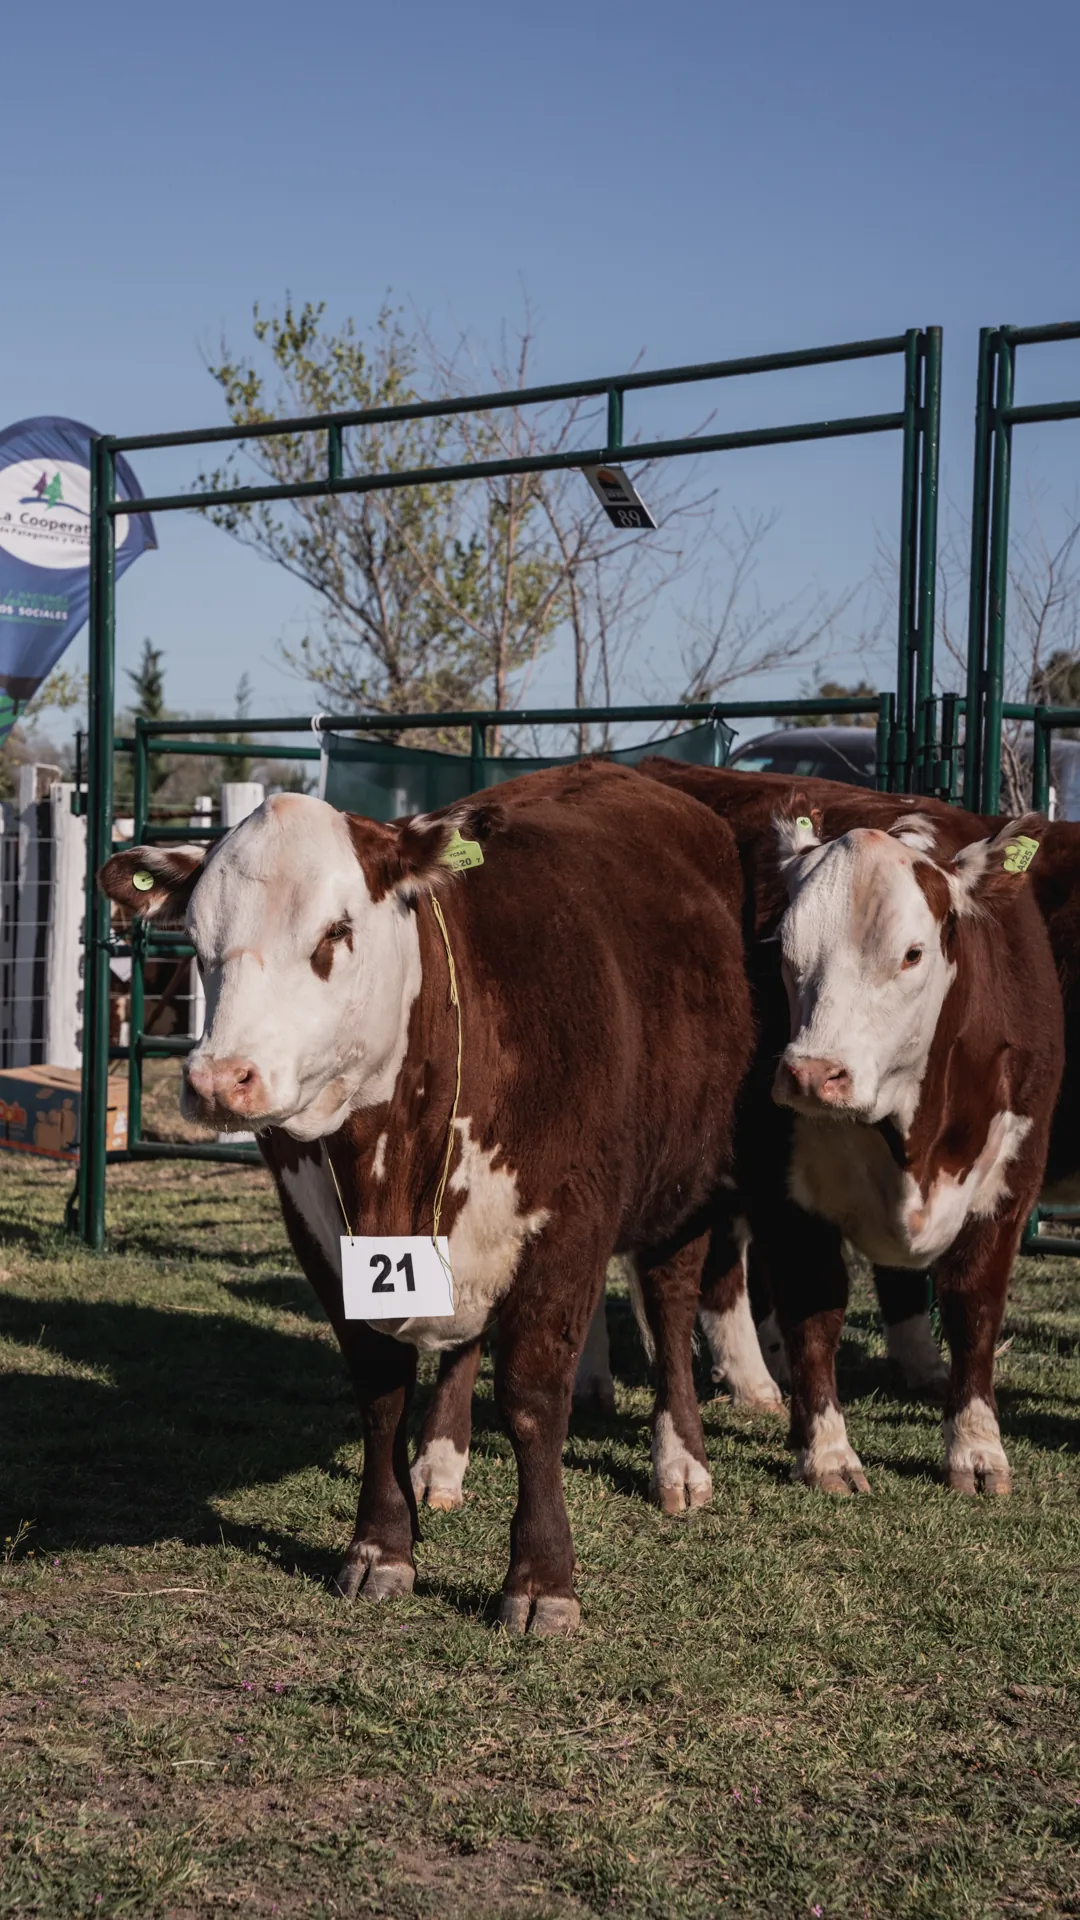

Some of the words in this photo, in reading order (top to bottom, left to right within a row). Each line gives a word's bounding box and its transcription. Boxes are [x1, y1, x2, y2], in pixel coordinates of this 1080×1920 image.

[0, 512, 12, 521] a
[617, 509, 641, 528] 89
[18, 606, 68, 620] SOCIALES
[1017, 850, 1033, 871] A525
[369, 1252, 416, 1293] 21
